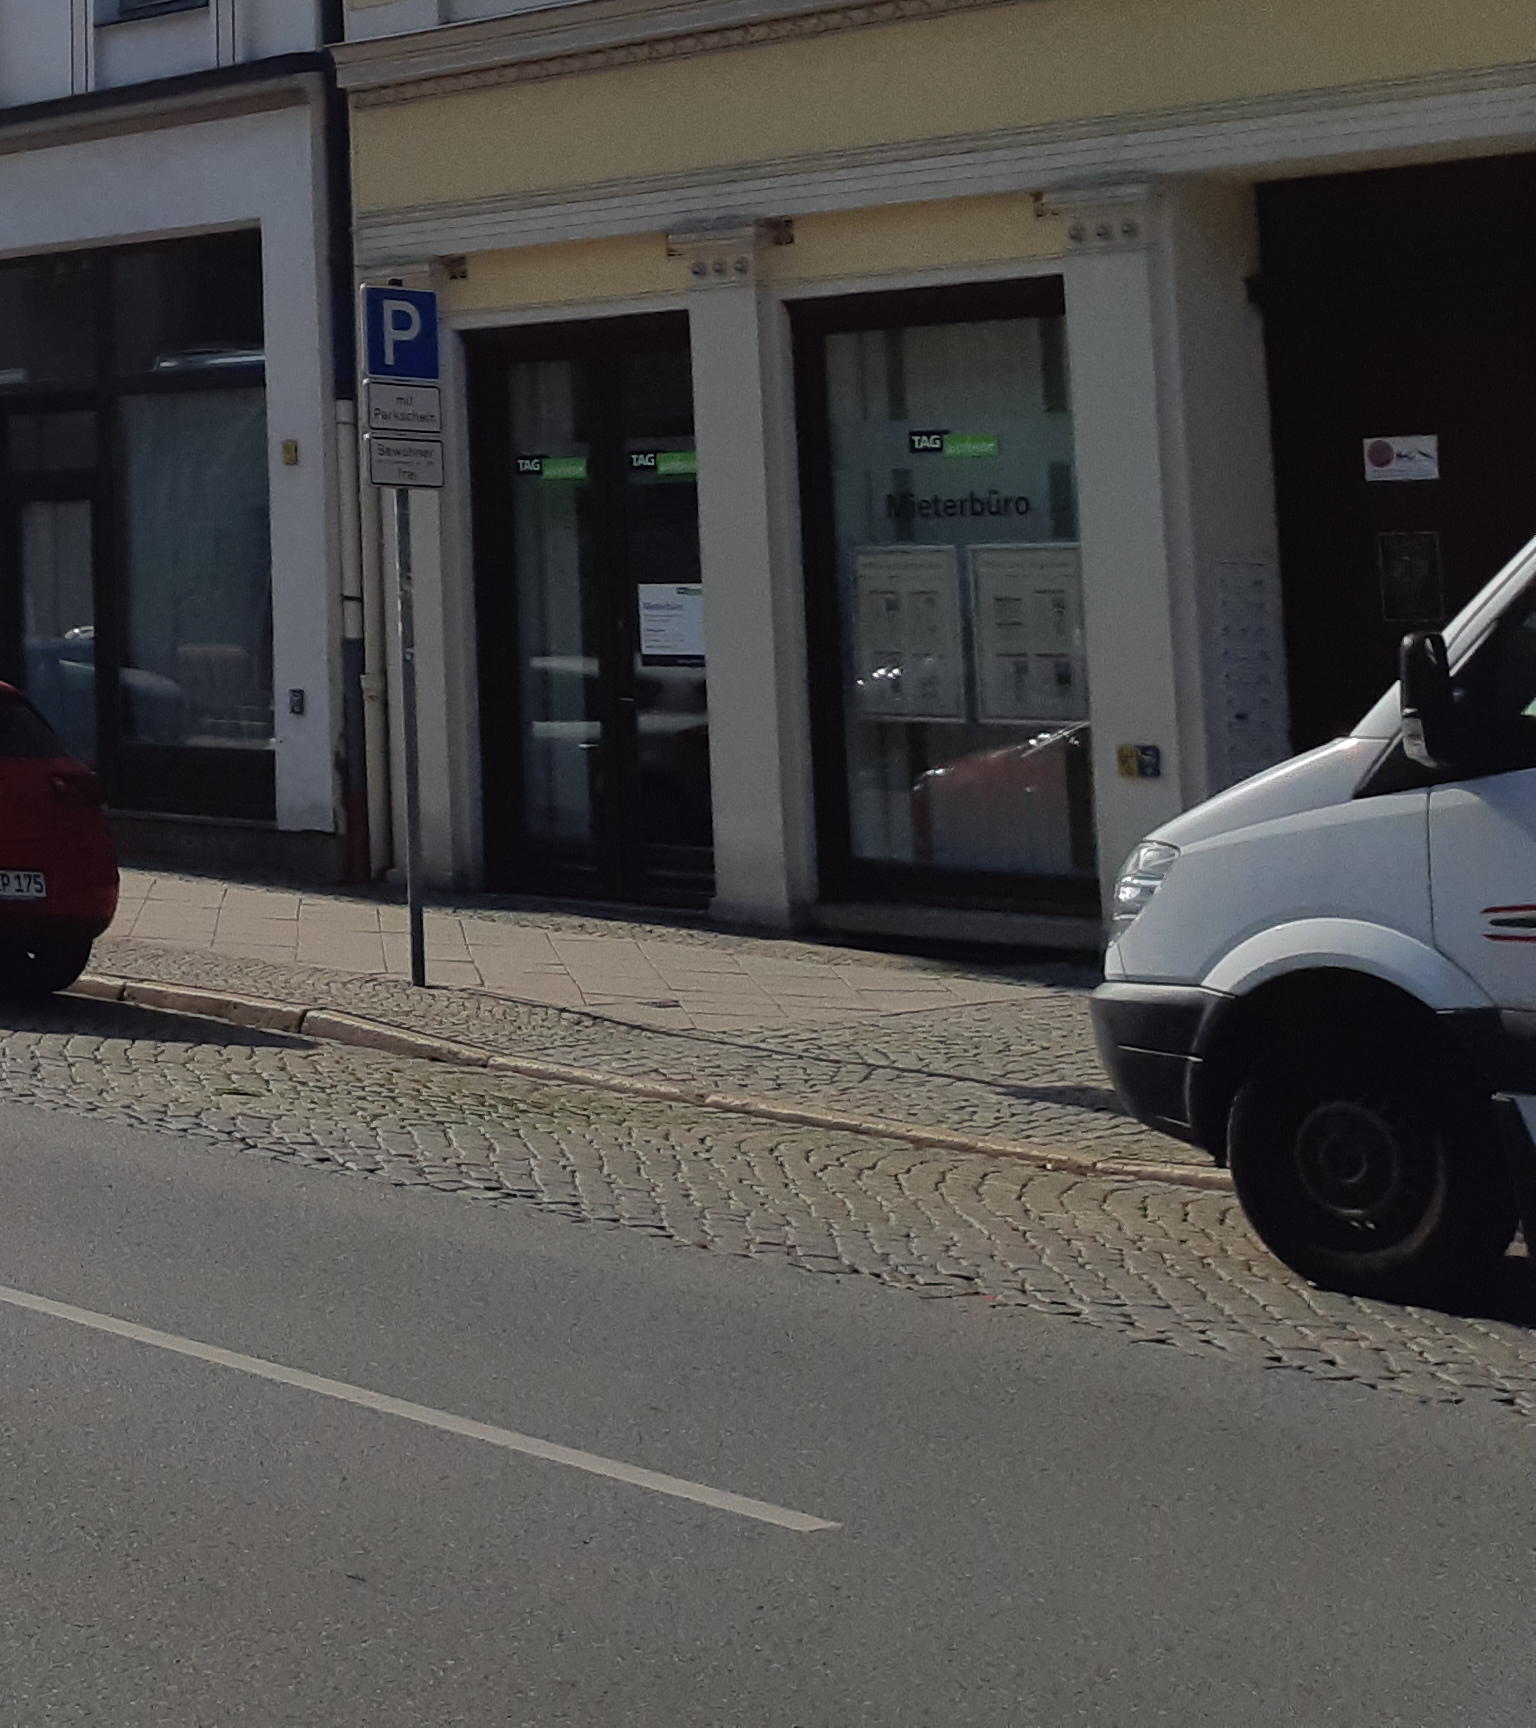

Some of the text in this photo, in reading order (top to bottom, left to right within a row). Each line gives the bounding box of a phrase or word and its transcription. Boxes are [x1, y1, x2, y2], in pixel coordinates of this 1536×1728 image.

[383, 299, 422, 366] P
[912, 435, 941, 449] TAG
[517, 459, 541, 471] TAG
[631, 454, 655, 466] TAG
[887, 490, 1032, 519] Mieterbüro
